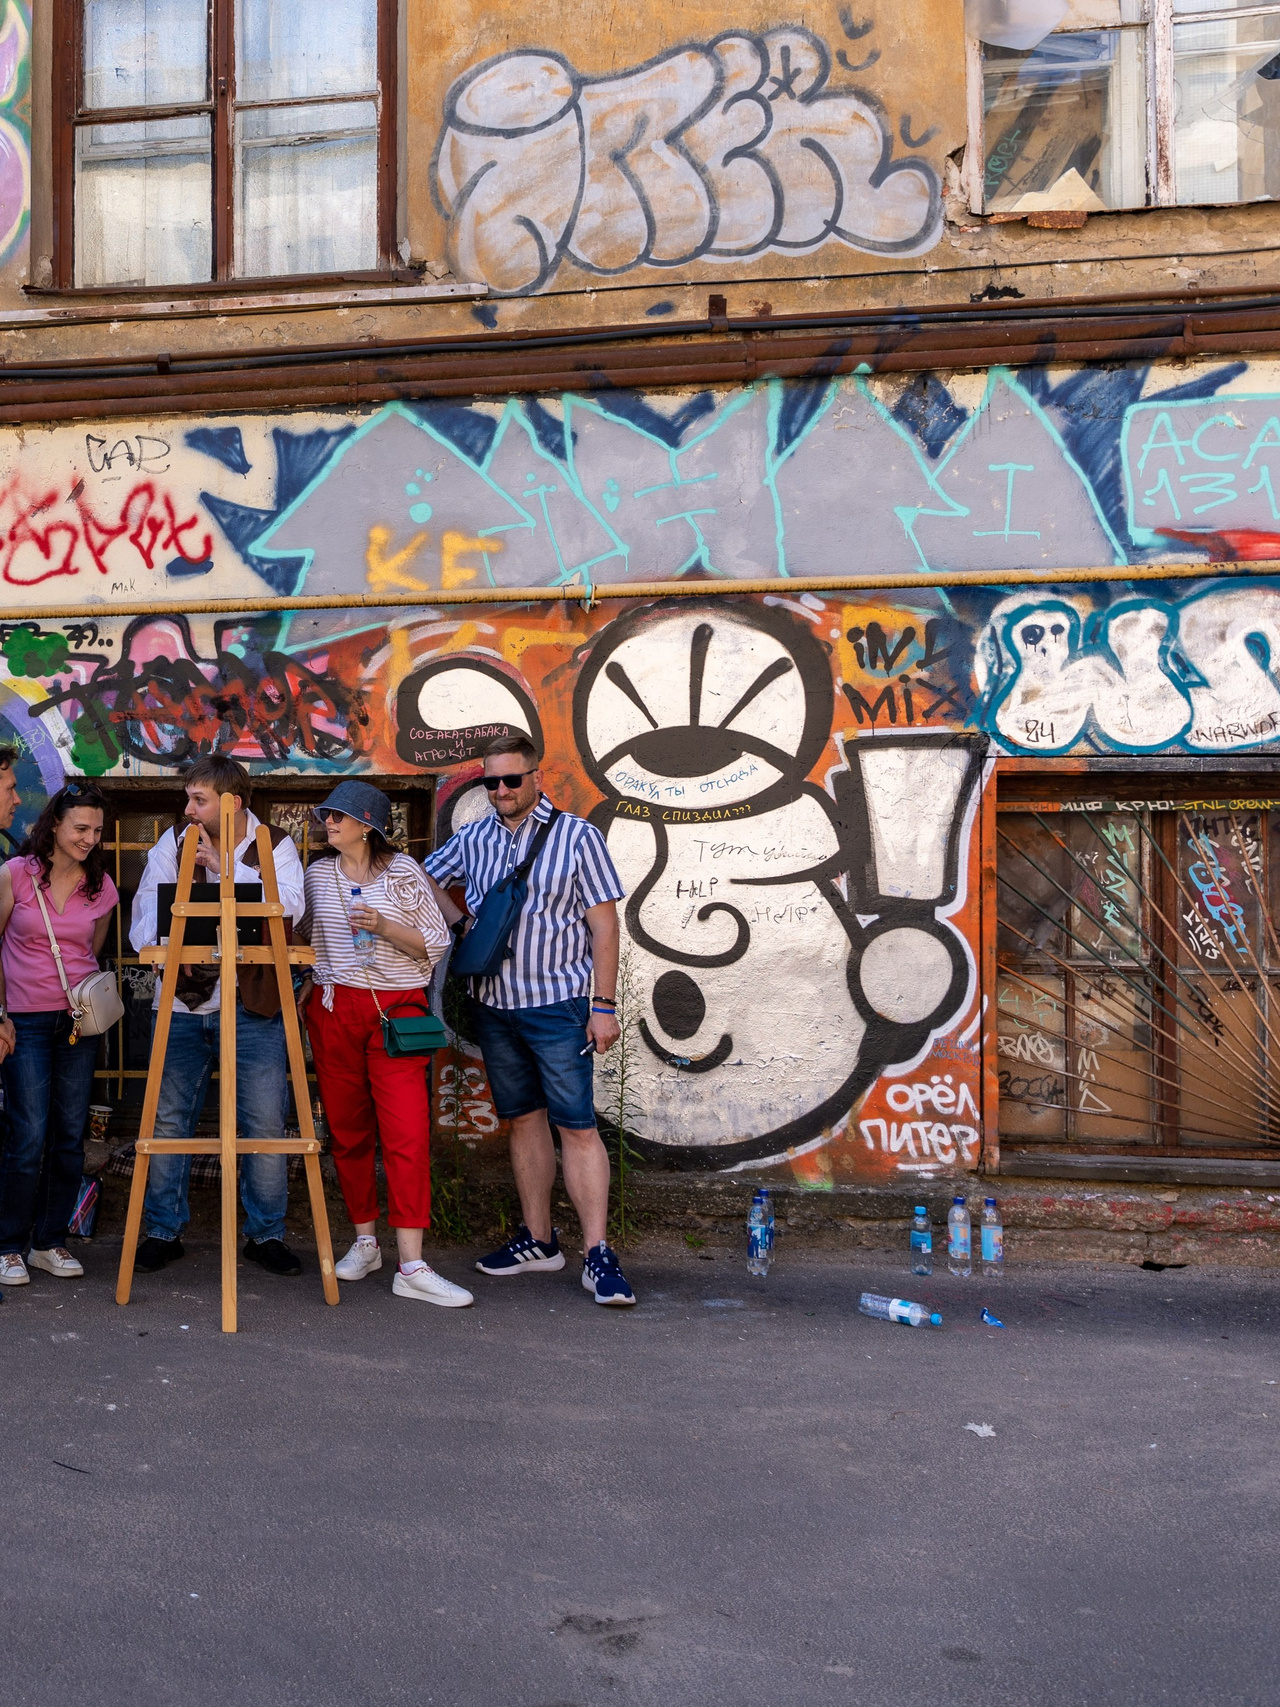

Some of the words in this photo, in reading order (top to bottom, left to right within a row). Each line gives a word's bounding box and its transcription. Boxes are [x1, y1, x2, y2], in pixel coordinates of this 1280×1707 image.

[409, 725, 509, 740] СОБАКА-БАБАКА
[414, 746, 476, 762] АГРОКОТ
[665, 785, 686, 797] ТЫ
[699, 763, 759, 794] ОТСЮДА
[615, 799, 652, 818] ГЛАЗ
